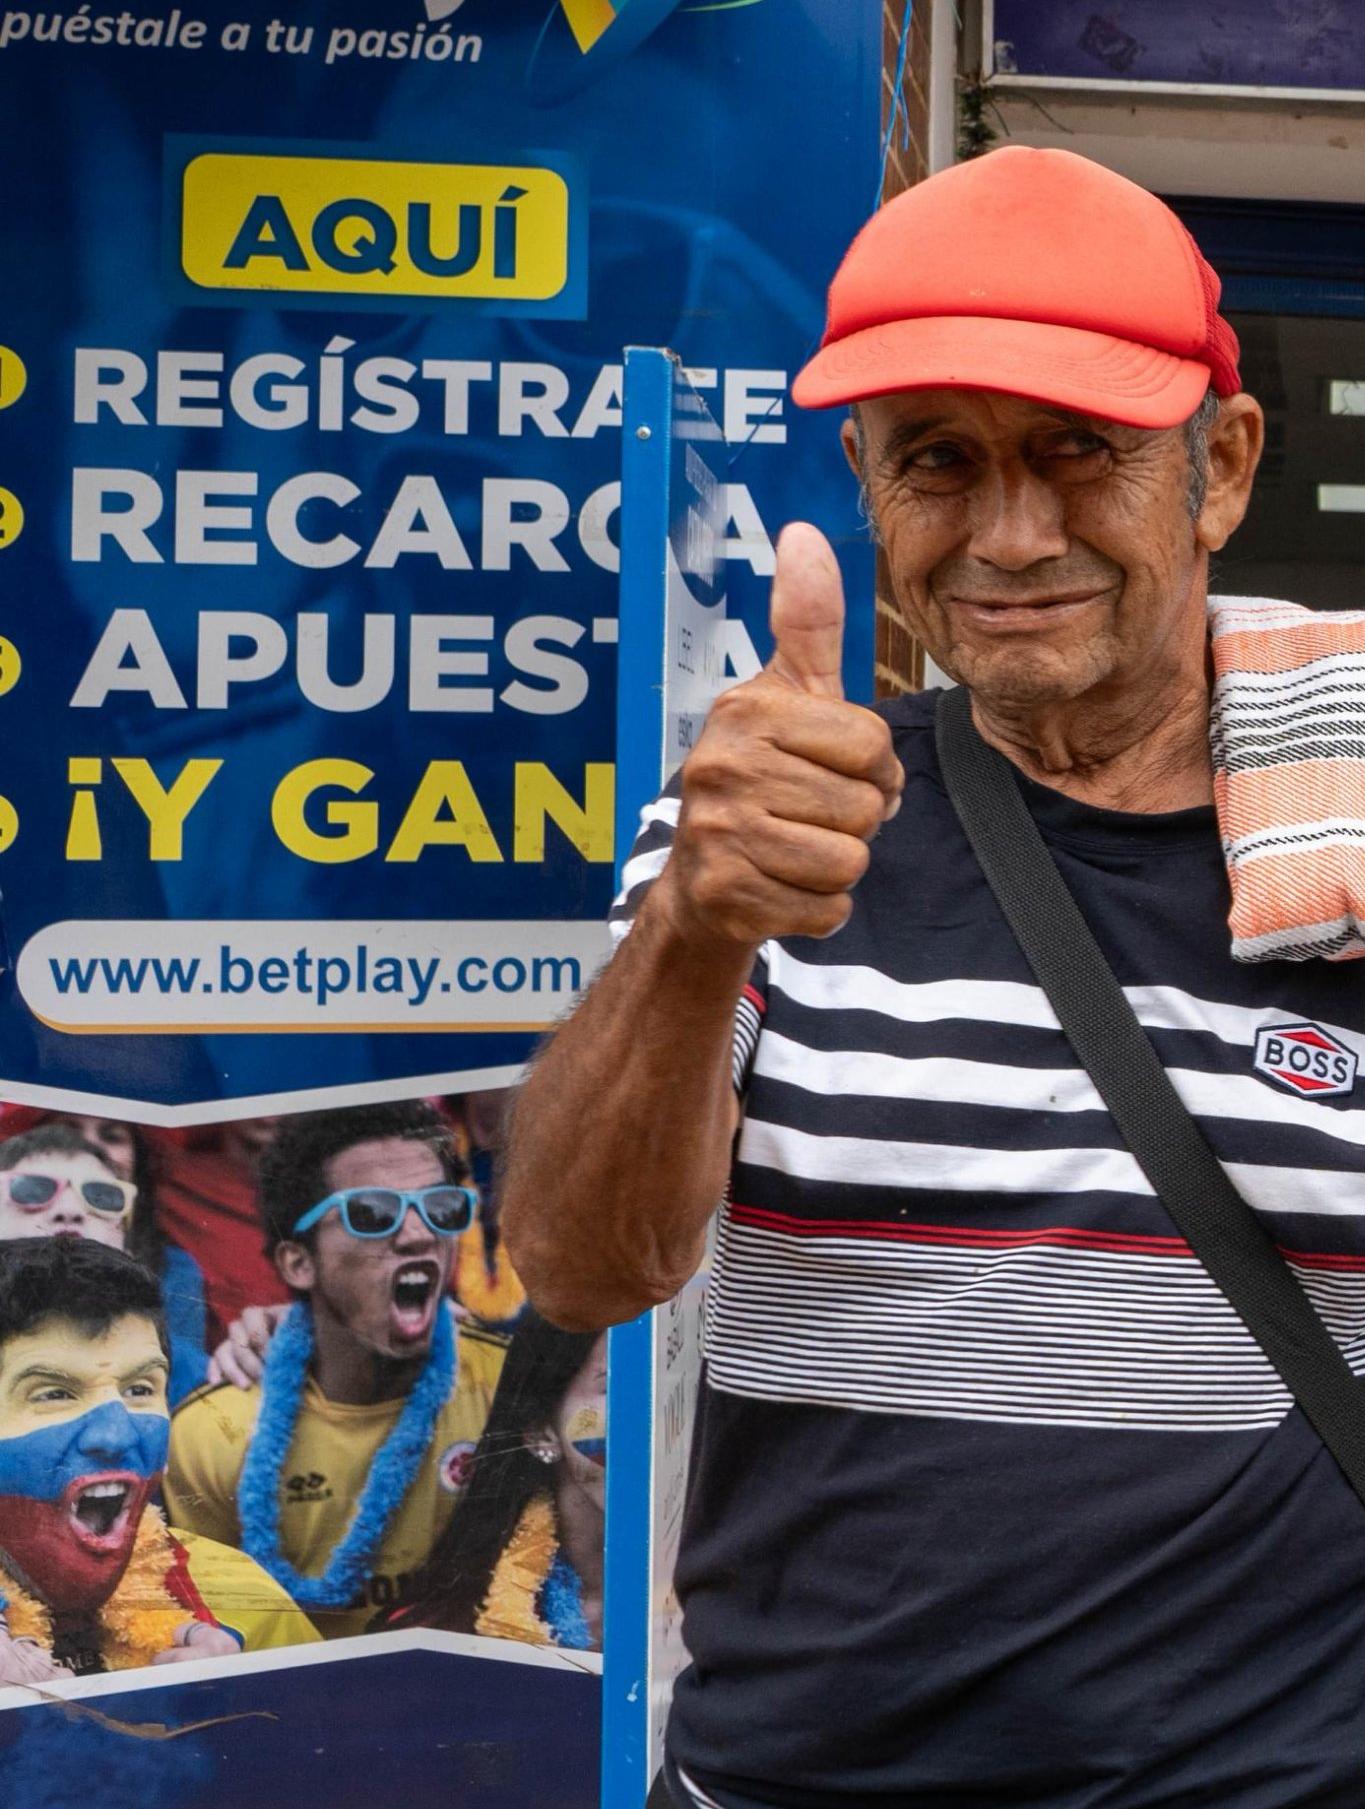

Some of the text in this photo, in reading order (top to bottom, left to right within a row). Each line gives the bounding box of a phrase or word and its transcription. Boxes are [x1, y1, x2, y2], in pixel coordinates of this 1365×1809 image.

[0, 5, 483, 64] puéstale a tu pasión
[222, 185, 529, 278] AQUÍ
[72, 336, 788, 444] REGÍSTRAE
[69, 607, 766, 714] APUES
[67, 757, 225, 862] ¡Y
[50, 943, 582, 1007] www.betplay.com
[1264, 1038, 1348, 1083] BOSS
